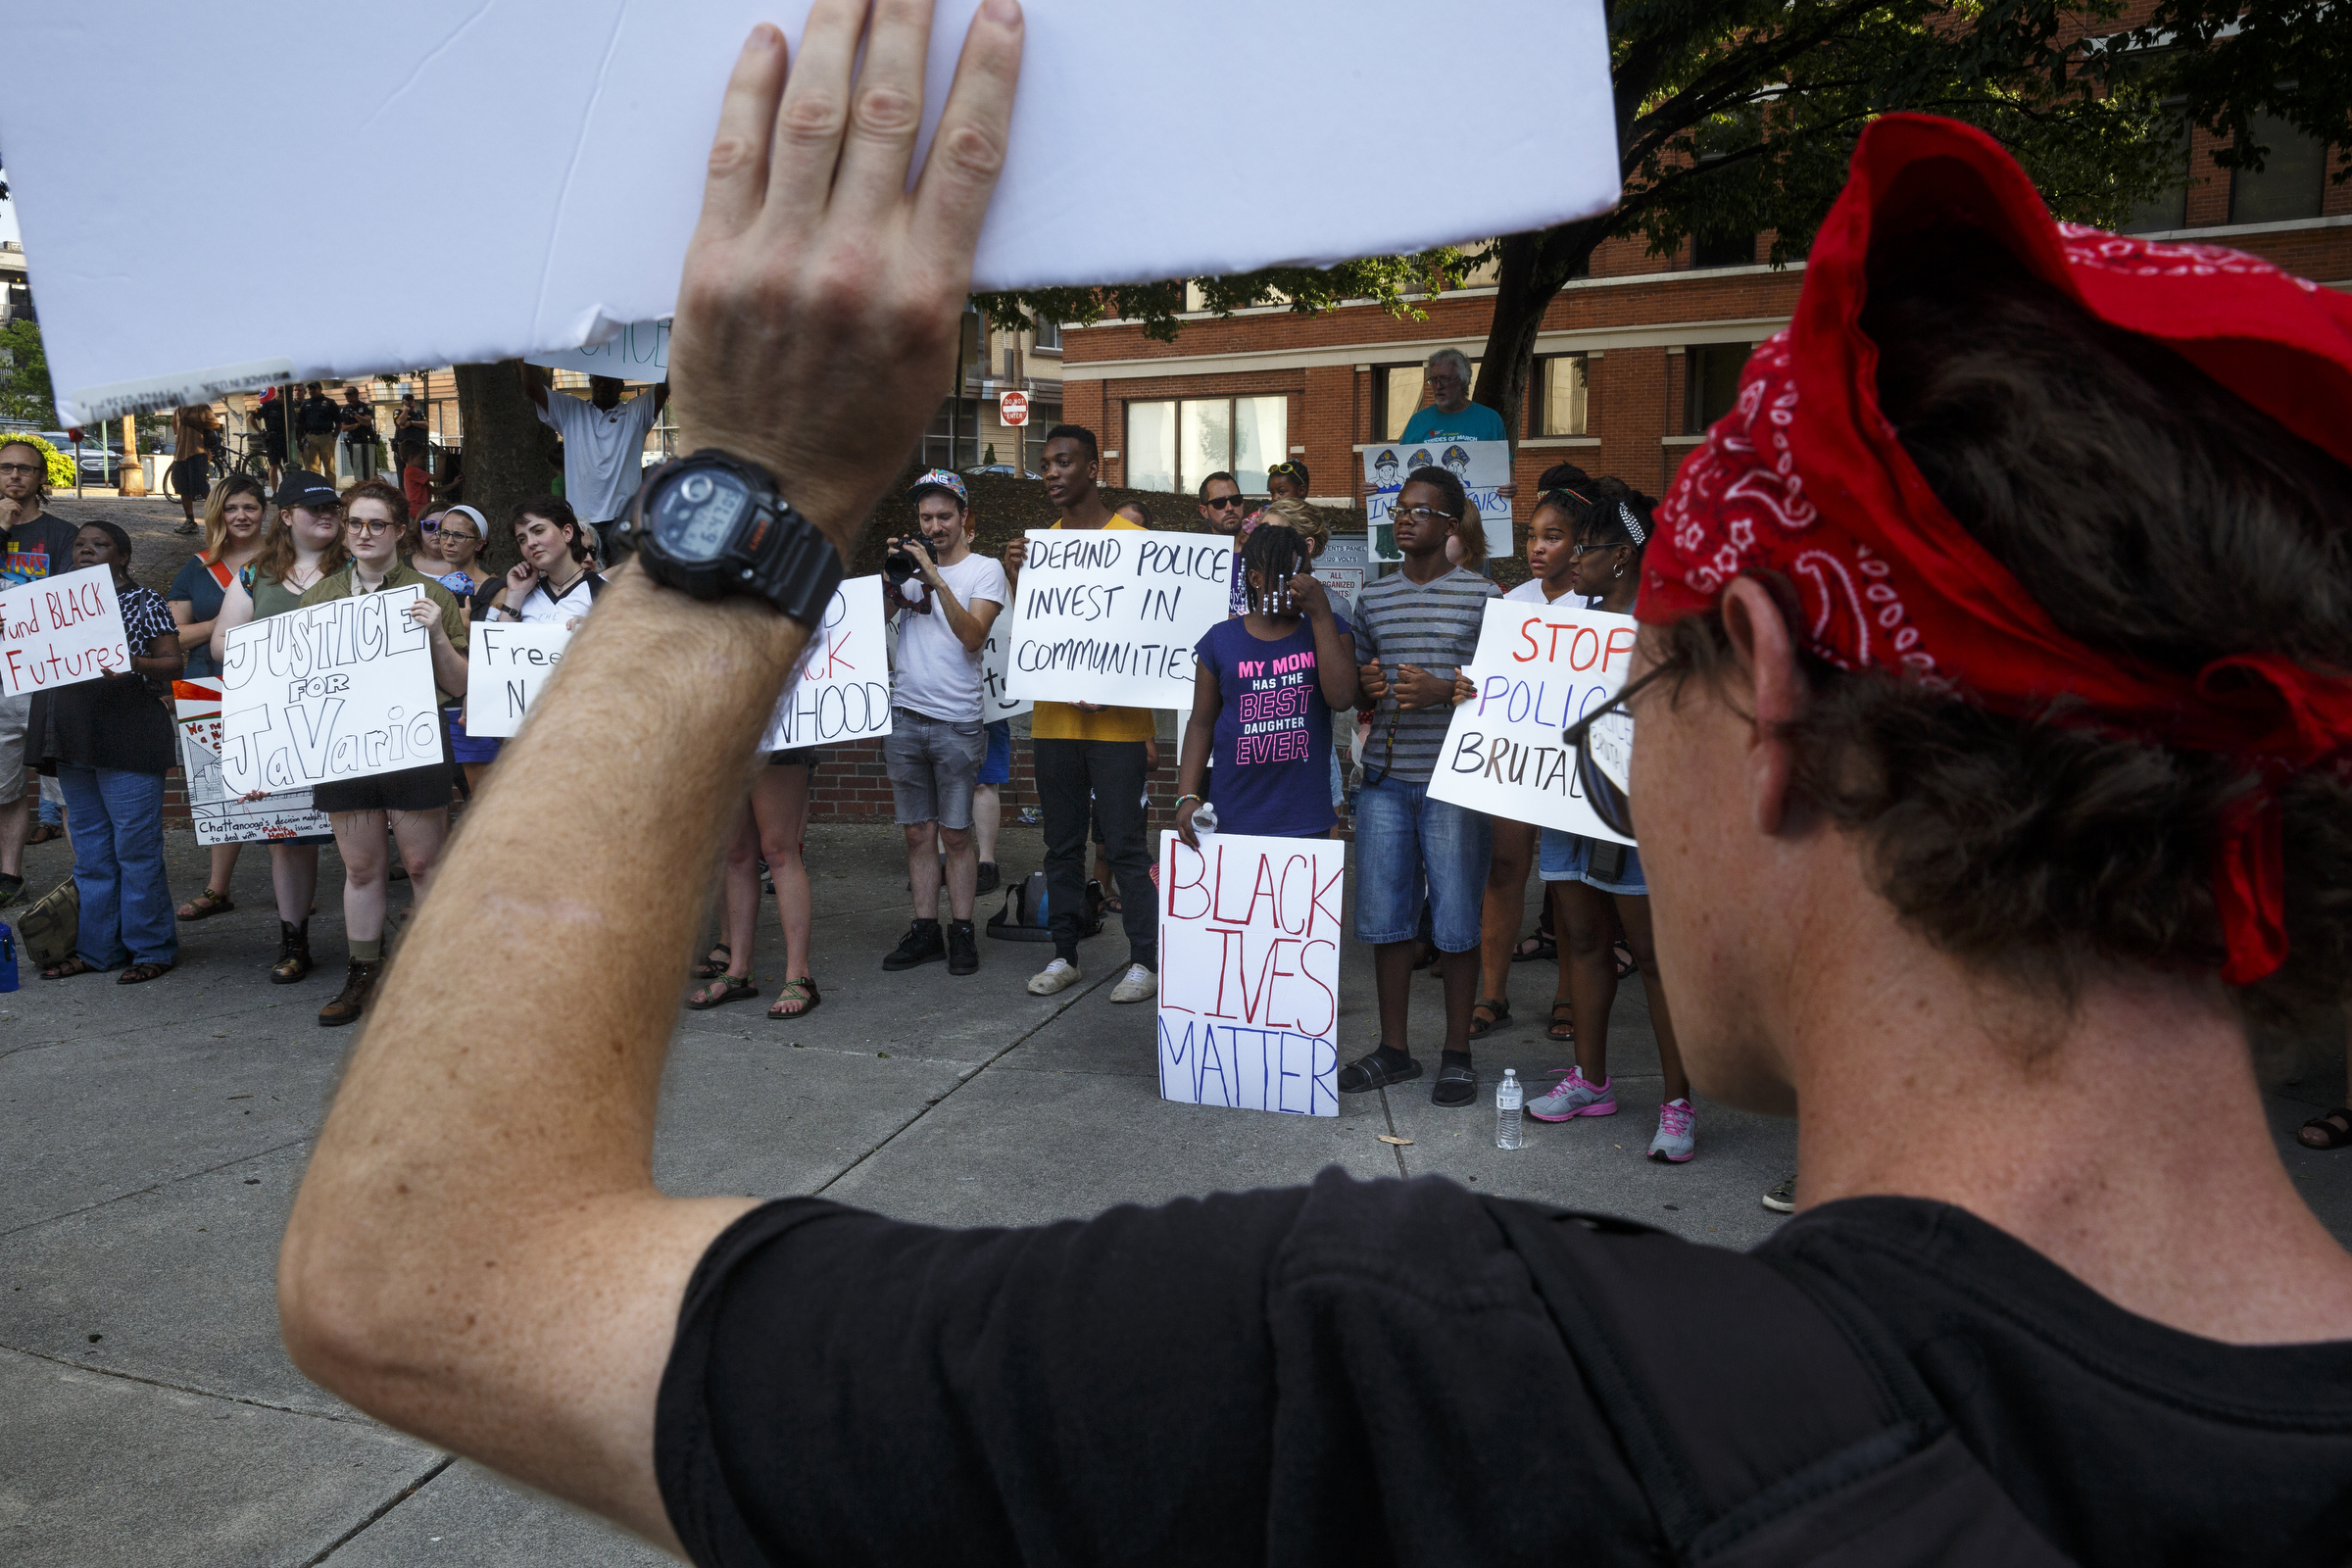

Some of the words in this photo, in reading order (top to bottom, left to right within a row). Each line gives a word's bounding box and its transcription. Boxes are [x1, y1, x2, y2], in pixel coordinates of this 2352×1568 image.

[1029, 538, 1121, 570] DEFUND
[1137, 540, 1230, 583] POLICE
[46, 582, 106, 630] BLACK
[1027, 584, 1125, 621] INVEST
[1141, 585, 1182, 622] IN
[222, 586, 426, 691] JUSTICE
[483, 628, 563, 666] Free
[1512, 616, 1637, 673] STOP
[6, 643, 124, 691] Futures
[1238, 661, 1265, 679] MY
[1272, 651, 1316, 676] MOM
[1252, 678, 1277, 691] HAS
[1281, 671, 1303, 687] THE
[289, 673, 350, 705] FOR
[1239, 684, 1314, 723] BEST
[1478, 675, 1606, 729] POLIC
[185, 722, 204, 736] We
[1244, 716, 1305, 735] DAUGHTER
[222, 697, 441, 797] JaVario
[1236, 729, 1309, 765] EVER
[199, 817, 270, 833] Chattanooga's
[274, 813, 300, 826] decision
[210, 834, 220, 843] to
[223, 832, 239, 841] deal
[242, 830, 257, 840] with
[262, 824, 288, 834] Public
[1168, 838, 1344, 938] BLACK
[1161, 923, 1336, 1038] LIVES
[1158, 1014, 1339, 1115] MATTER
